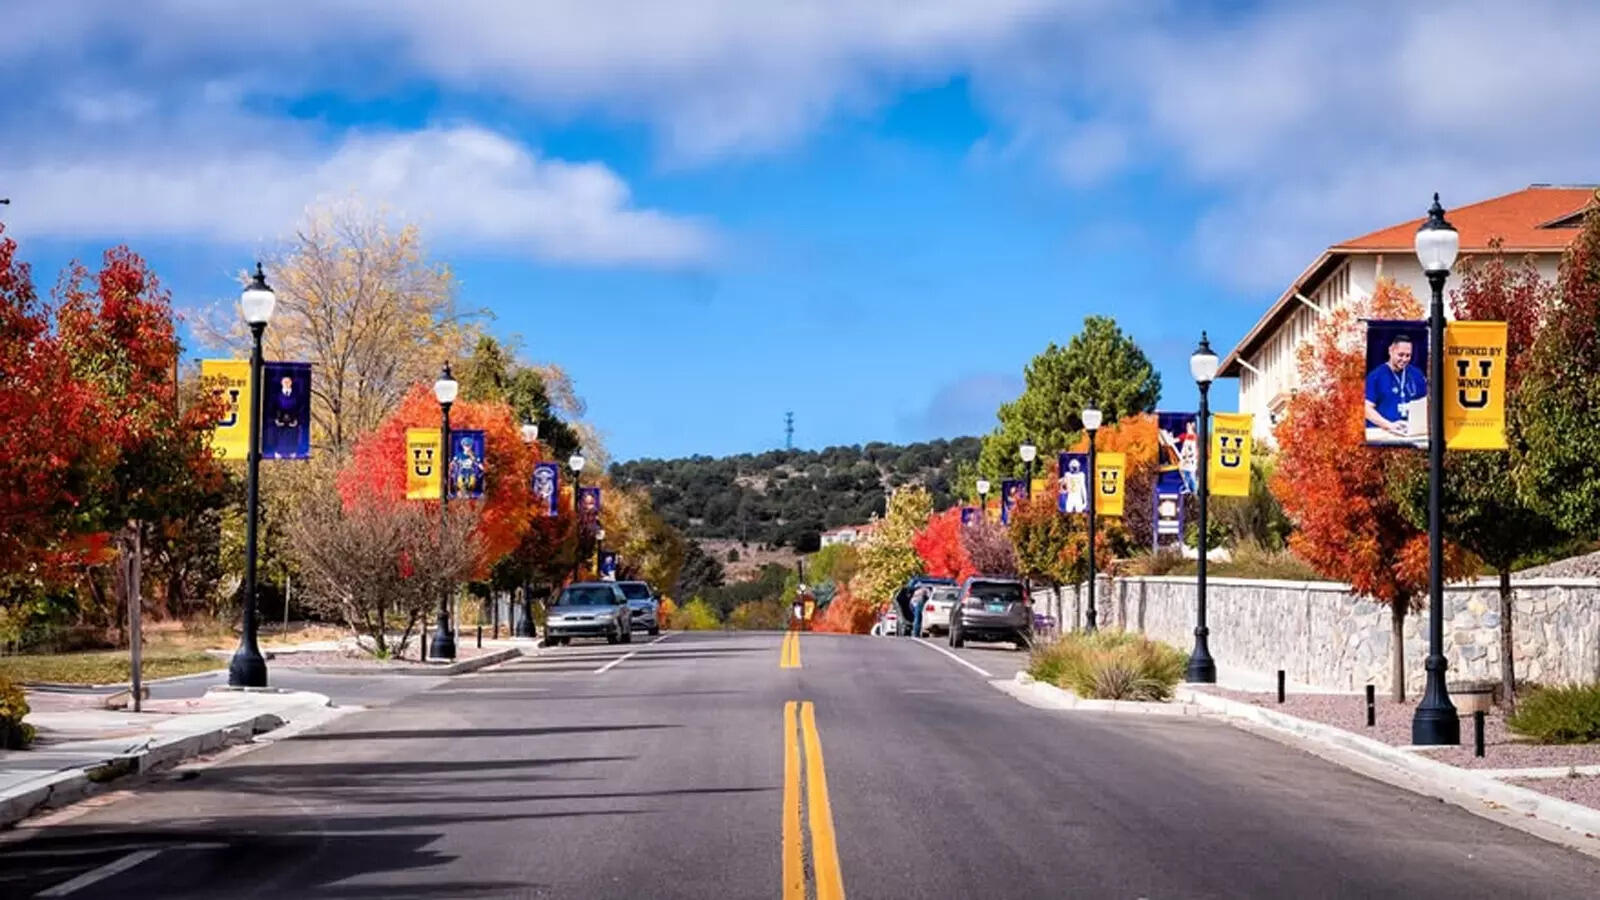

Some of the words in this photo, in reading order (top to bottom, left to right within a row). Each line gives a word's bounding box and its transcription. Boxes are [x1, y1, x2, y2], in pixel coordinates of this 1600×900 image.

[1448, 346, 1487, 356] DEFINED
[1489, 346, 1502, 356] BY
[1457, 378, 1491, 388] WNMU
